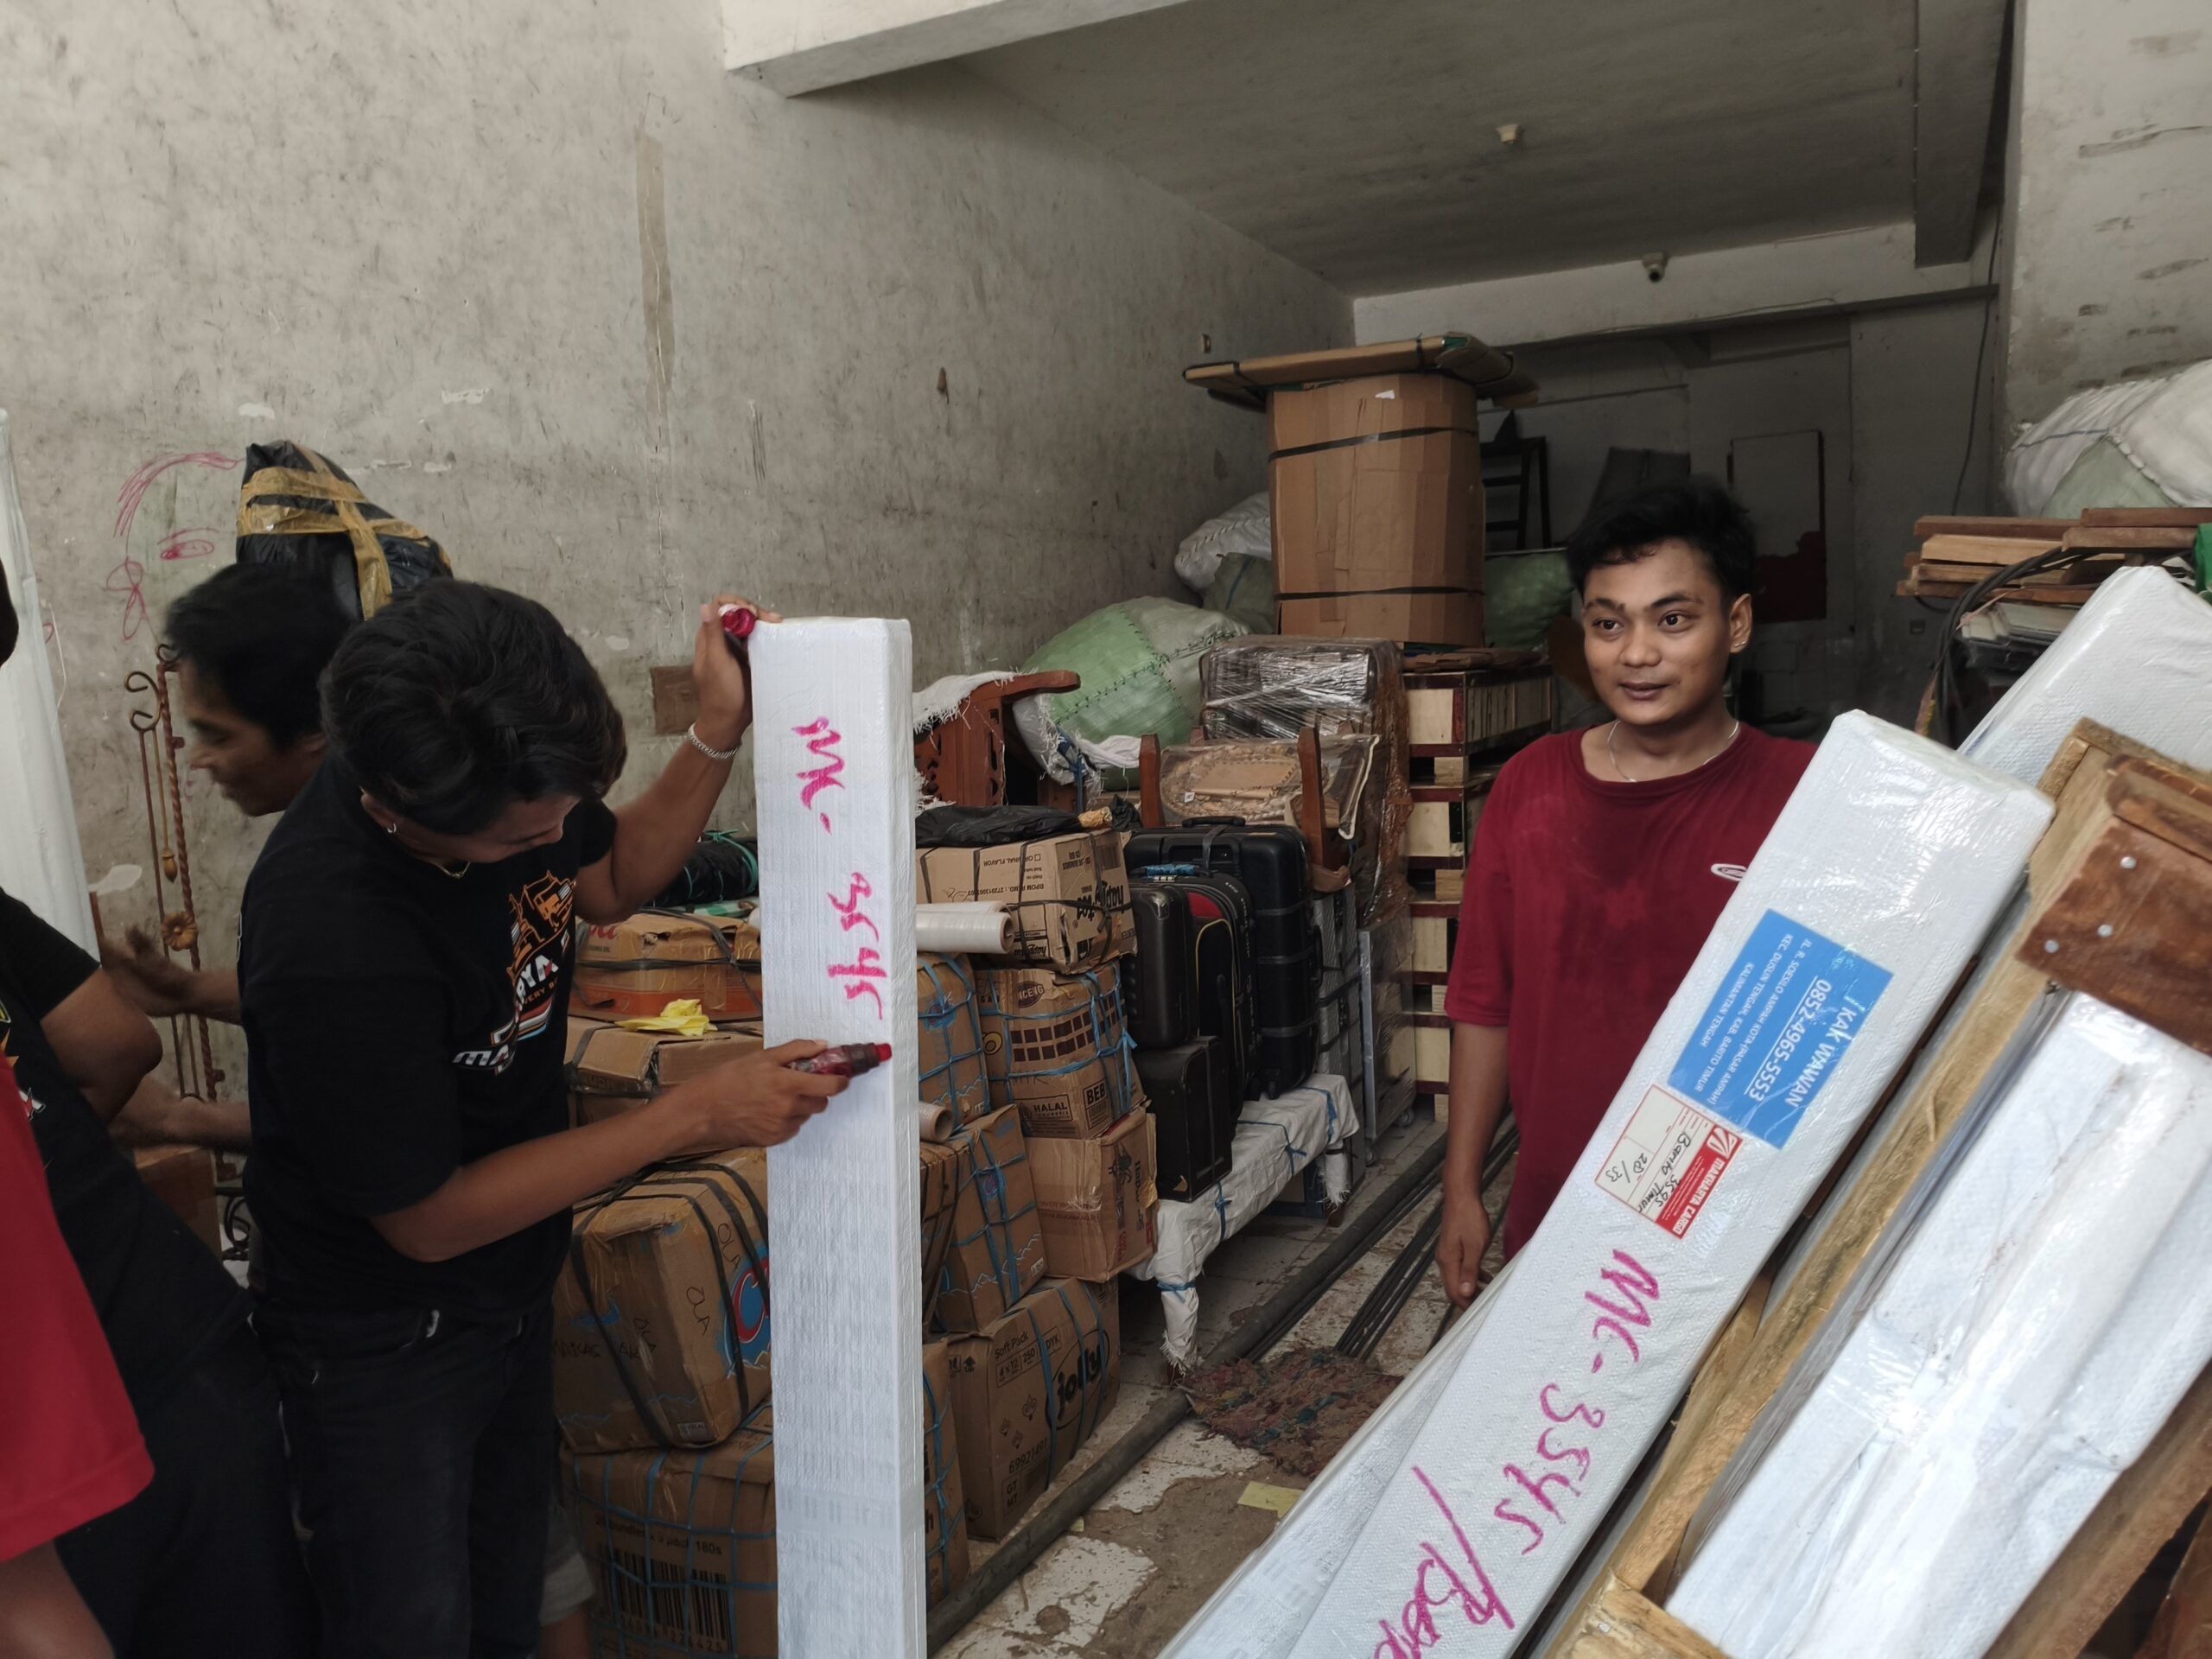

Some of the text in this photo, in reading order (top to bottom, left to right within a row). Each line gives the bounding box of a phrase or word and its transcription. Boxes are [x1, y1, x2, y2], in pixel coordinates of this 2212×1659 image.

[1699, 961, 1756, 1048] KALIMANTAN TENGAH
[1708, 1034, 1732, 1066] BARITO
[1747, 977, 1834, 1103] 0852-4965-5553
[1783, 1005, 1857, 1109] KAK WAWAN
[1694, 1064, 1715, 1093] TIMUR
[1033, 1102, 1068, 1112] HALAL
[1671, 1205, 1696, 1236] CARGO
[995, 1341, 1011, 1360] Soft
